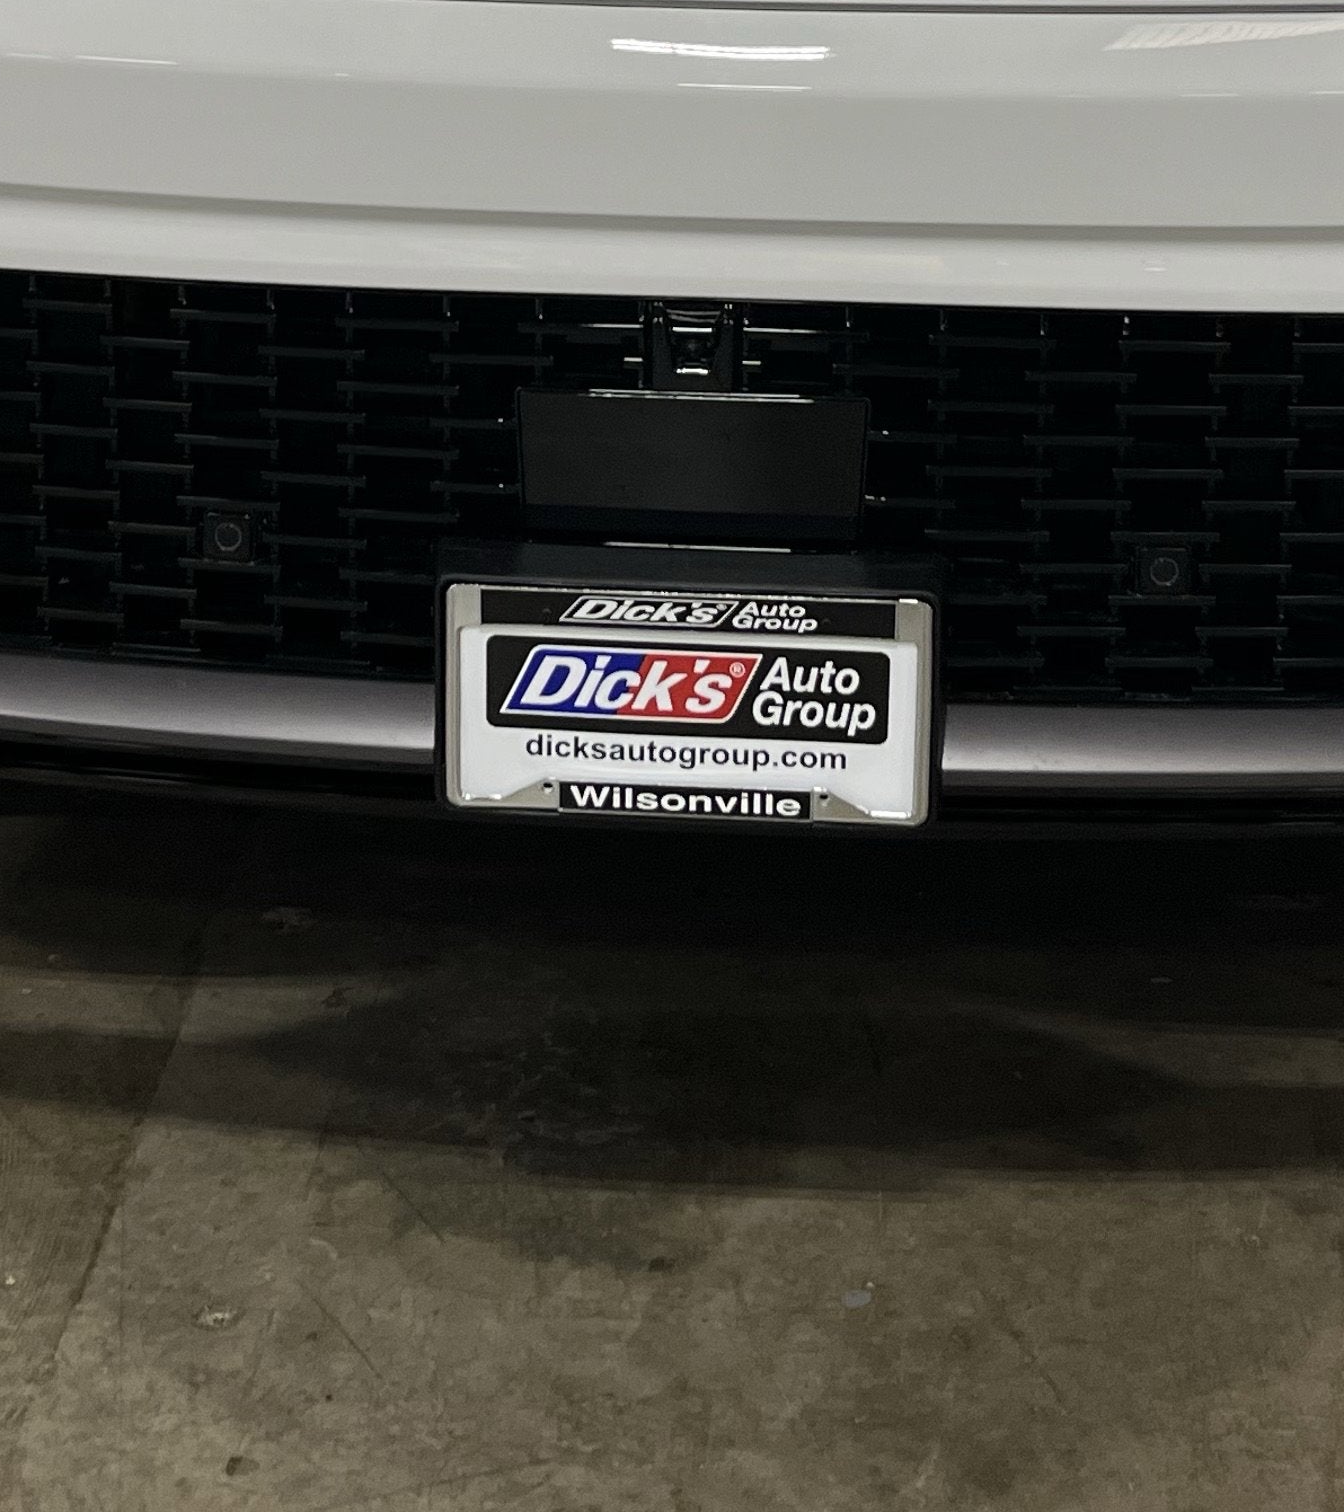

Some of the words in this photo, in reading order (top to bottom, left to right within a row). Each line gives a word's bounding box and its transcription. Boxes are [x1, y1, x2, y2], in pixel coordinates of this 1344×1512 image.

[731, 612, 818, 634] Group
[739, 600, 806, 617] Auto
[759, 656, 860, 696] Auto
[752, 692, 877, 736] Group
[525, 734, 847, 771] dicksautogroup.com
[570, 784, 802, 817] Wilsonville
